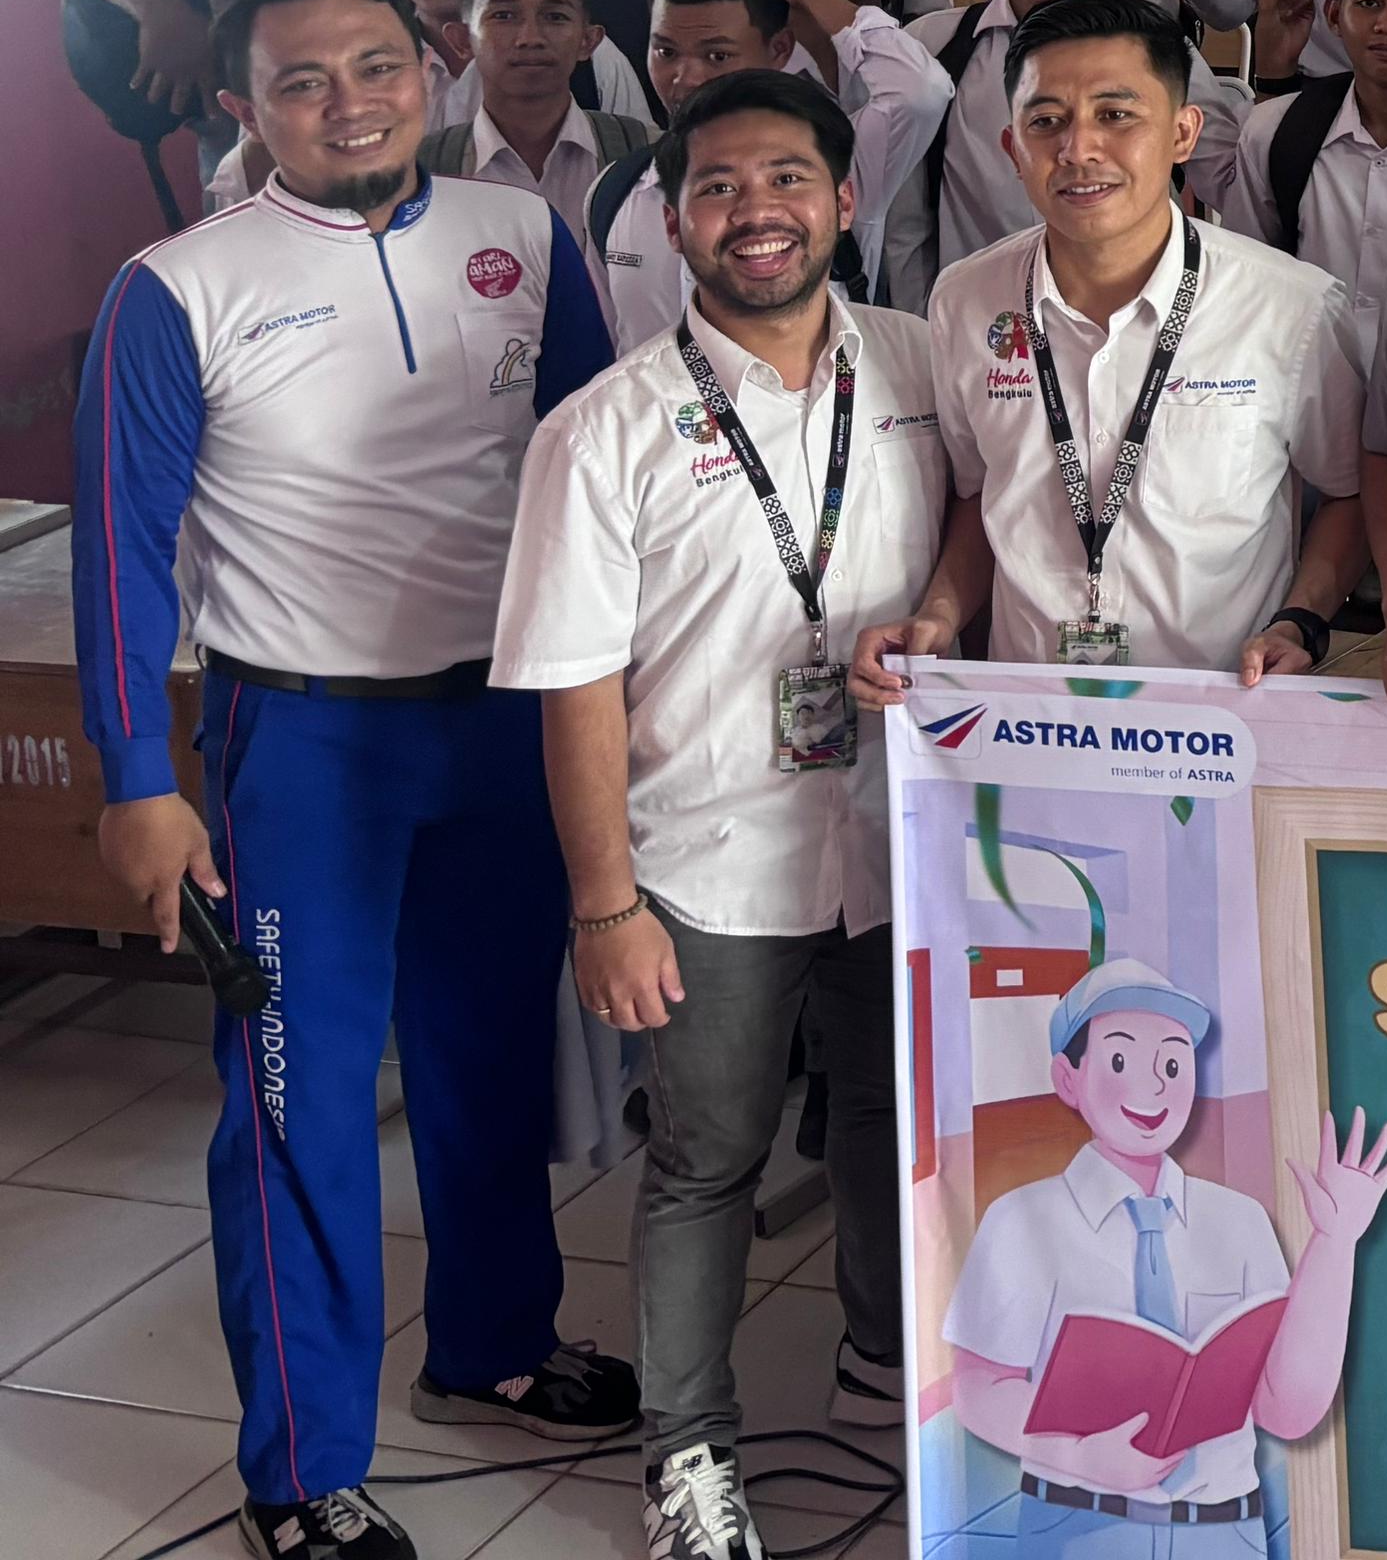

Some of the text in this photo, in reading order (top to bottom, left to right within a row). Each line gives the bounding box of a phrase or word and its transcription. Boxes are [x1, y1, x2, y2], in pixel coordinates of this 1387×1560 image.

[265, 315, 298, 332] ASTRA
[299, 305, 336, 321] MOTOR
[987, 369, 1034, 388] Honda
[1185, 378, 1257, 390] ASTRA MOTOR
[988, 389, 1032, 401] Bengkulu
[690, 449, 739, 477] Hond
[696, 465, 746, 488] Bengkul
[992, 719, 1234, 757] ASTRA MOTOR
[7, 734, 71, 787] 2015
[1111, 766, 1235, 783] member of ASTRA
